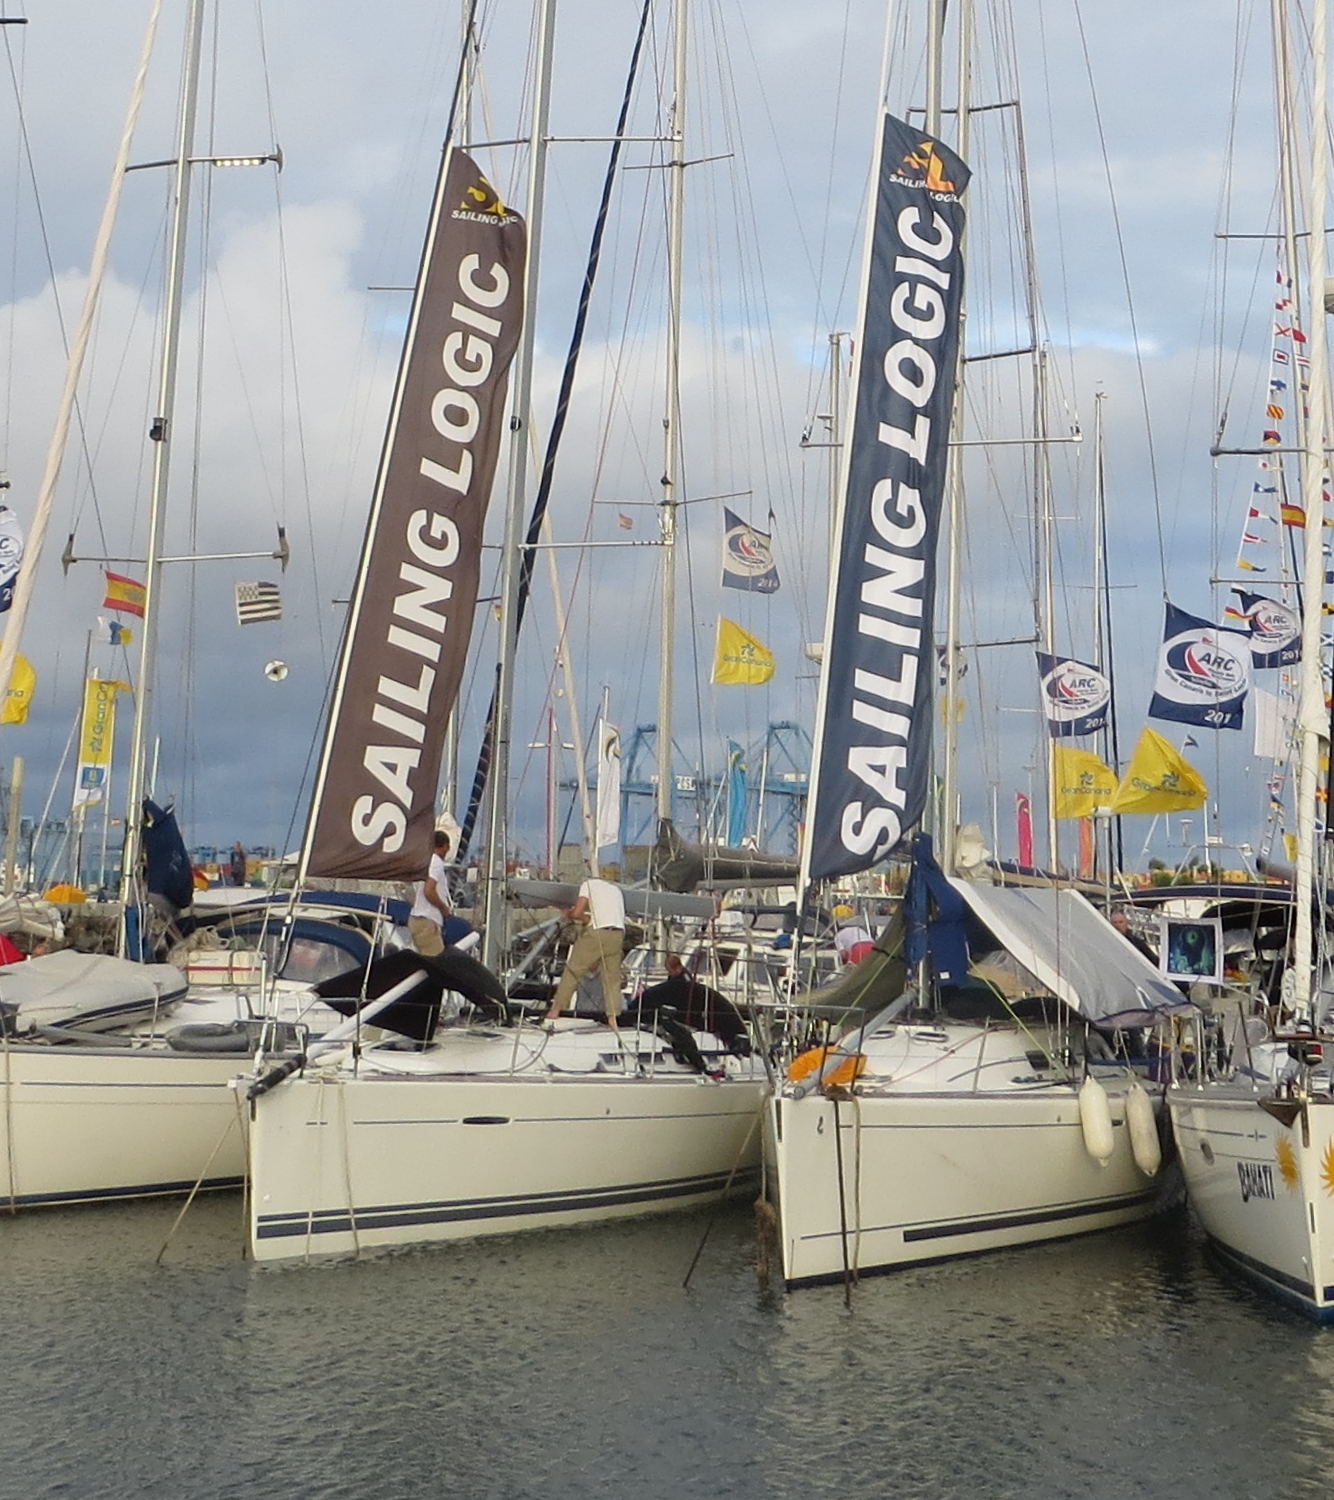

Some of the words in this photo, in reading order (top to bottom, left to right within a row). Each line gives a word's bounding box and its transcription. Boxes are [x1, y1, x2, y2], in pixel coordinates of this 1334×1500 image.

[451, 210, 498, 226] SAILING
[878, 205, 955, 454] LOGIC
[351, 508, 460, 853] SAILING
[419, 253, 510, 496] LOGIC
[1264, 614, 1287, 624] ARC
[841, 477, 929, 861] SAILING
[1197, 652, 1235, 671] ARC
[1069, 677, 1097, 689] ARC
[1237, 1161, 1275, 1202] BAHATI
